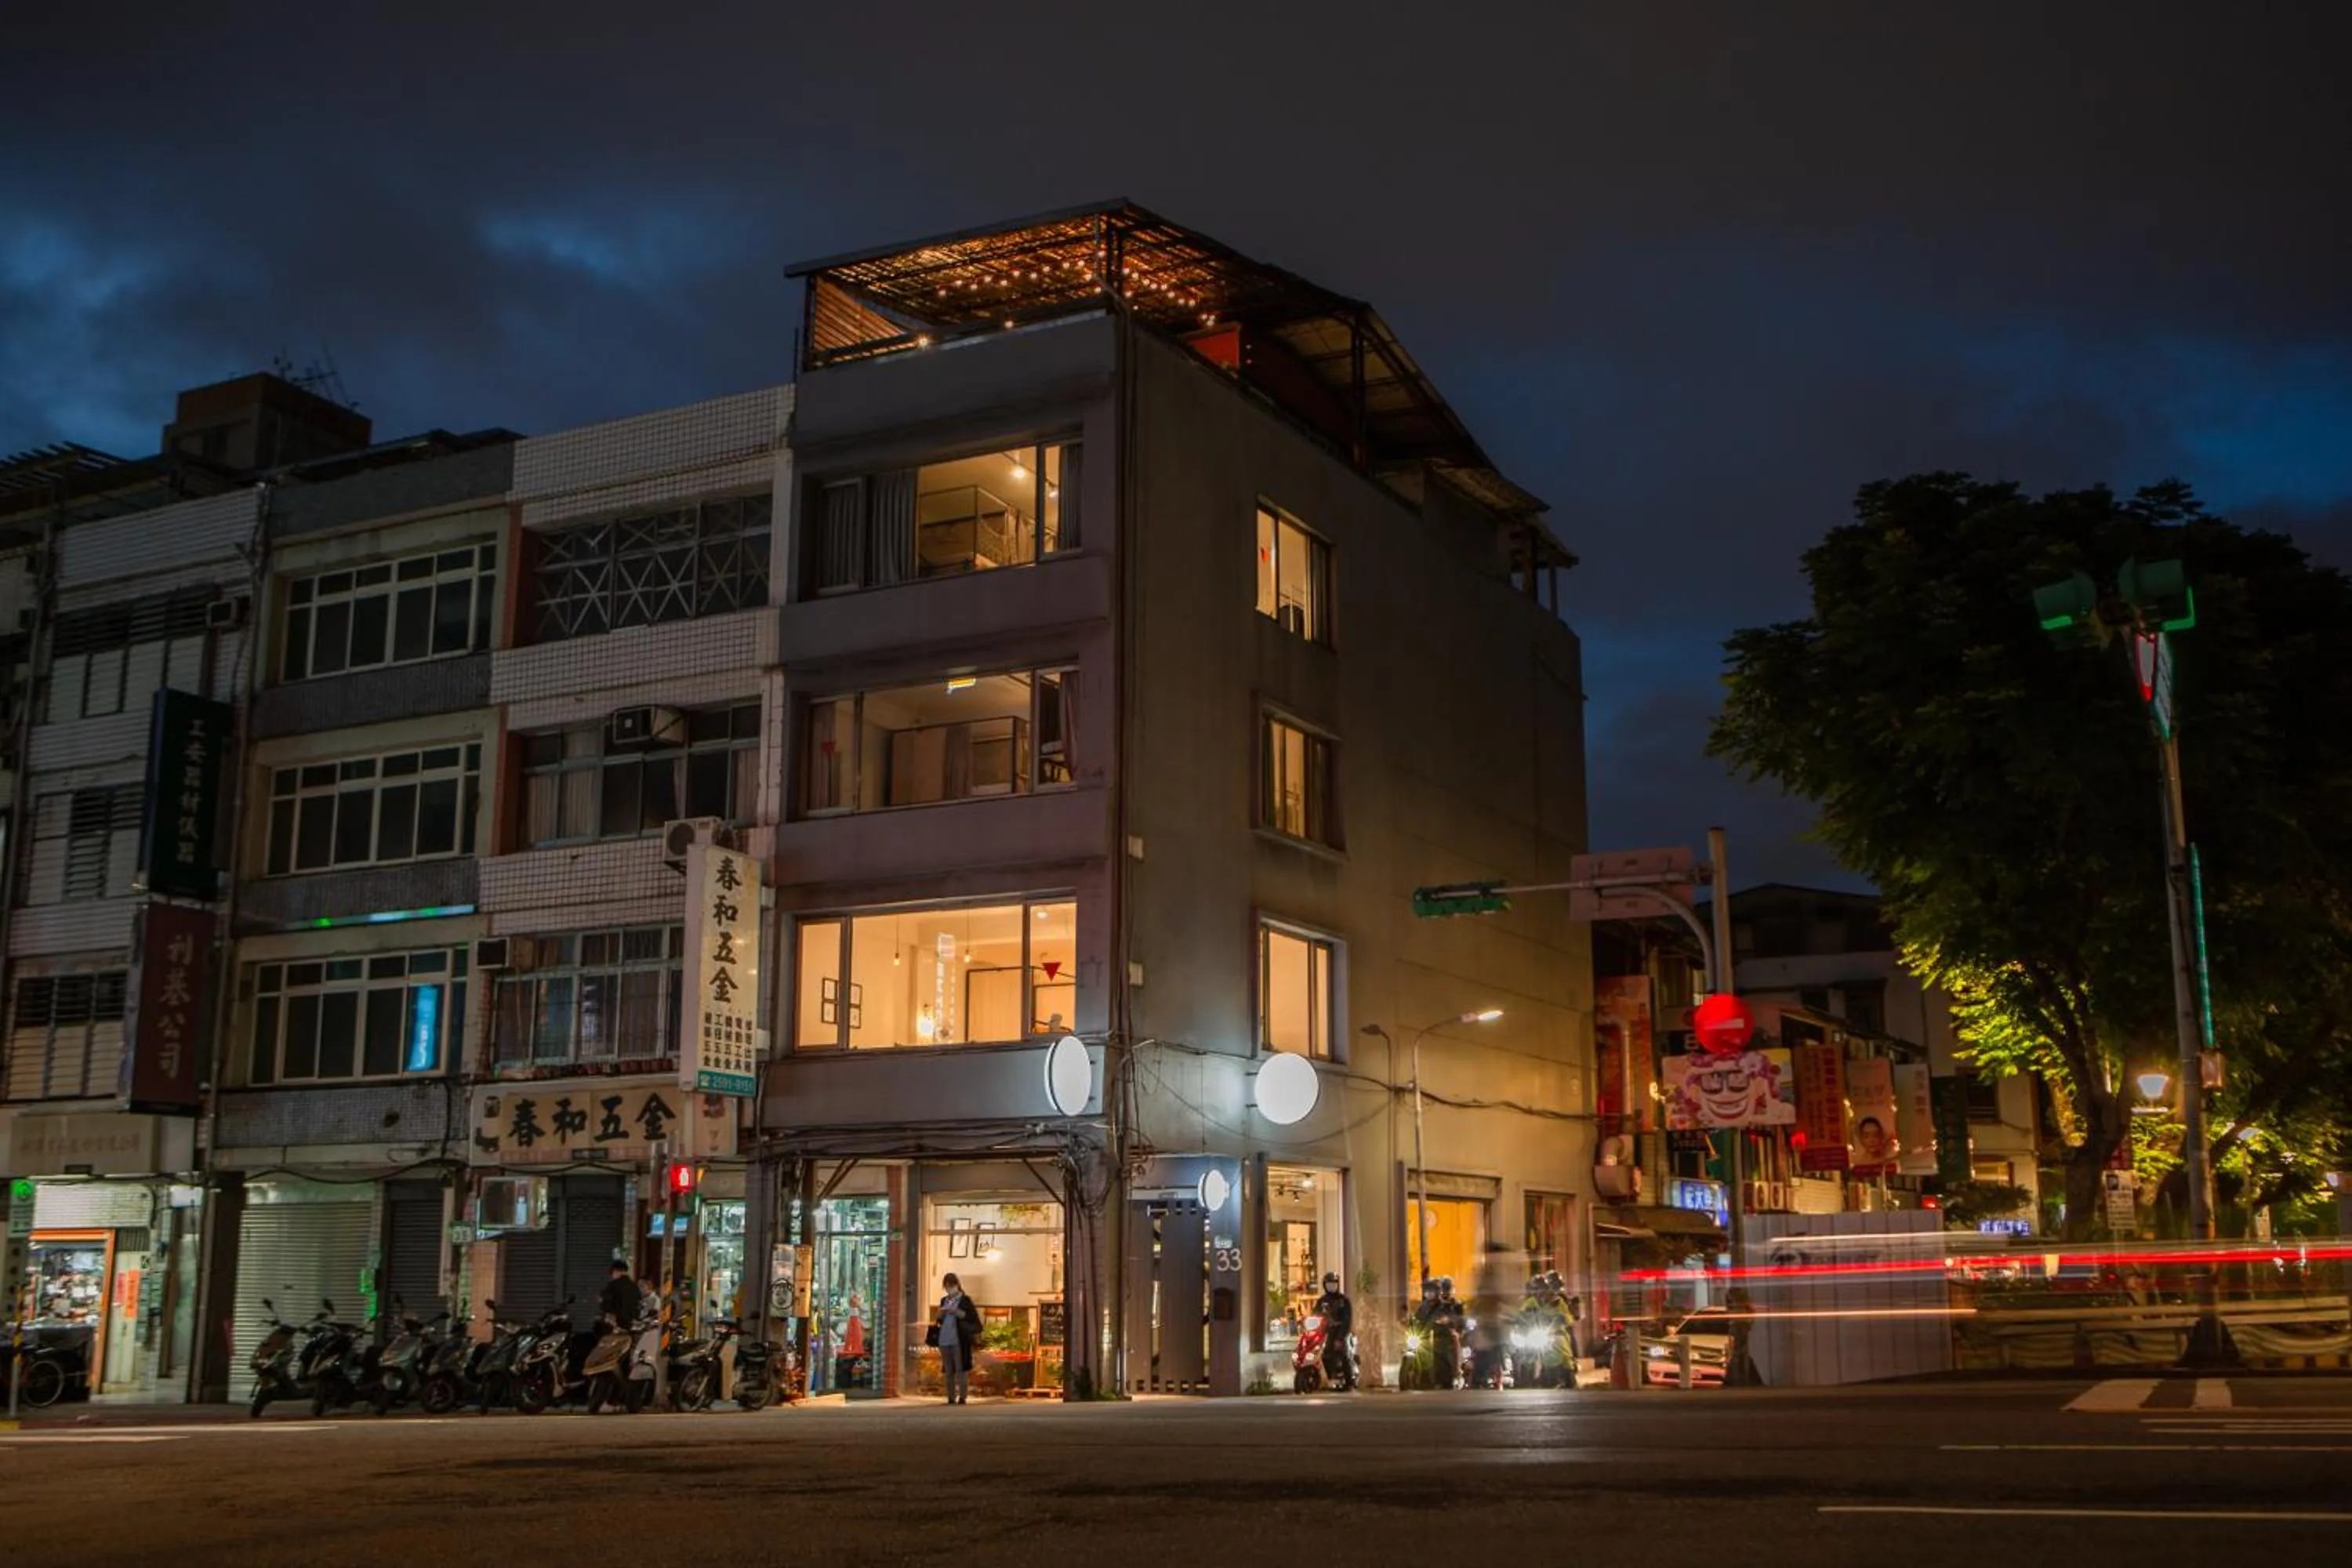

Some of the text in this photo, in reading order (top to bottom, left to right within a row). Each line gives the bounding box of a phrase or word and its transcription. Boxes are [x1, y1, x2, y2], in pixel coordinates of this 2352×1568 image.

[710, 855, 742, 1004] 春和五金
[509, 1092, 676, 1147] 春和五金
[1217, 1247, 1242, 1272] 33
